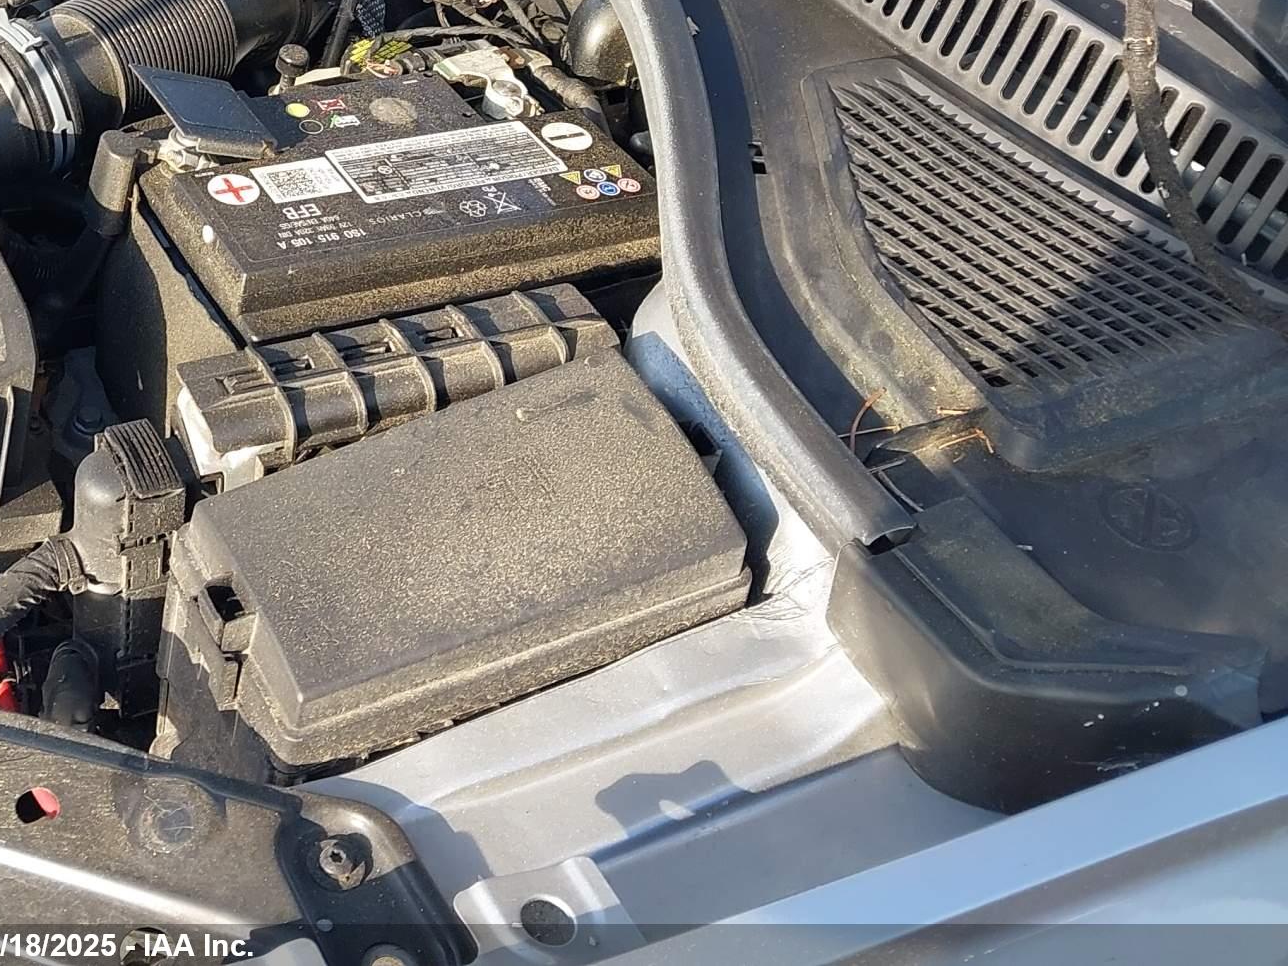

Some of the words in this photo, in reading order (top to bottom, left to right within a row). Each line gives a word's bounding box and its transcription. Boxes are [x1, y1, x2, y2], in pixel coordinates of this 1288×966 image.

[282, 203, 322, 220] EFB
[368, 210, 422, 225] CLARIOS
[291, 237, 314, 247] 105
[317, 232, 340, 243] 915
[276, 241, 287, 250] A
